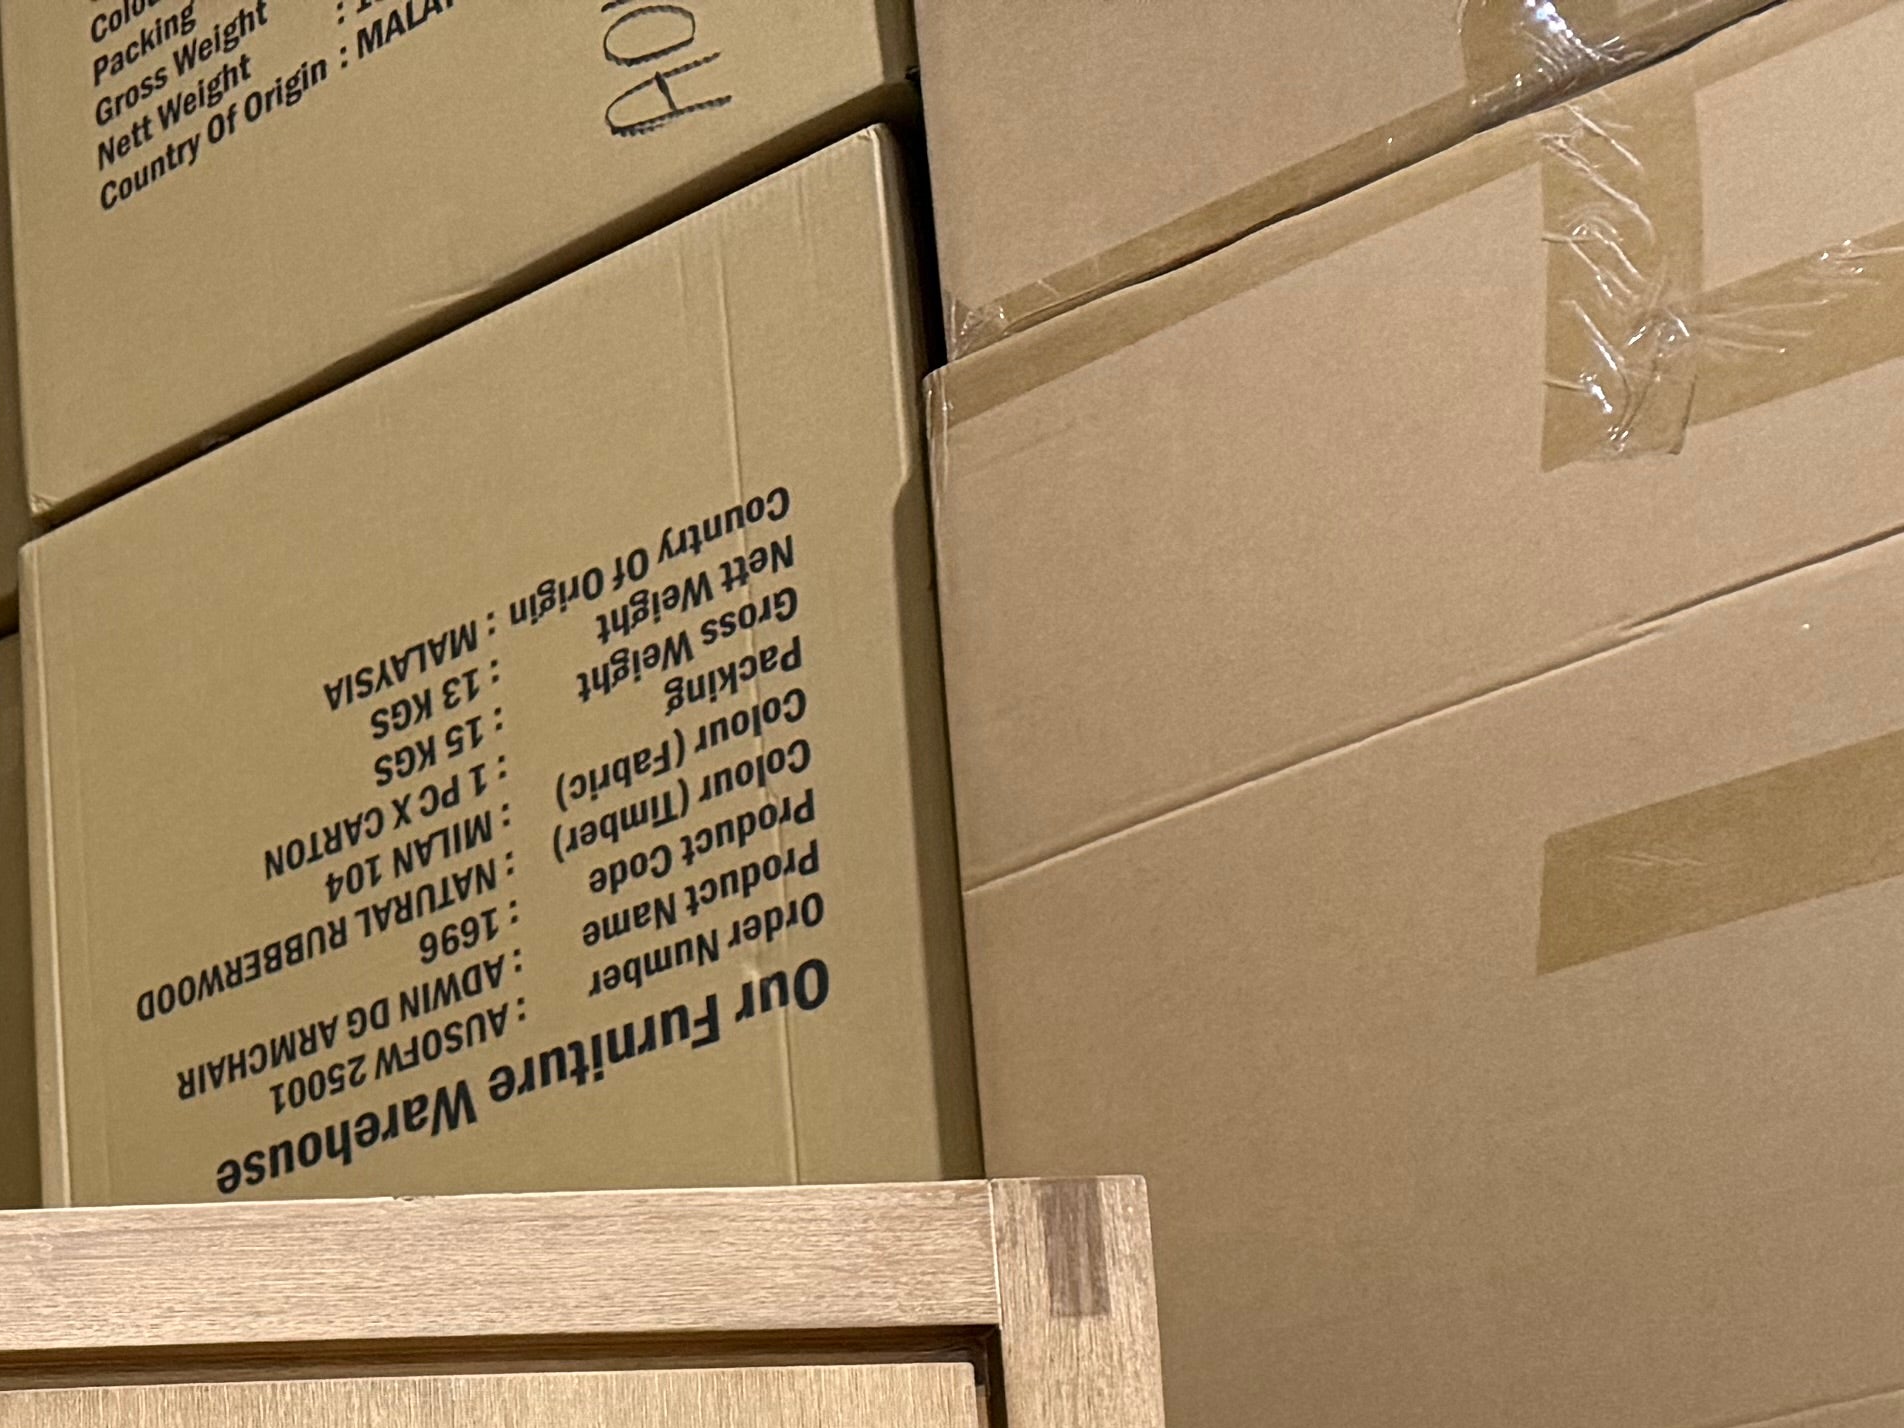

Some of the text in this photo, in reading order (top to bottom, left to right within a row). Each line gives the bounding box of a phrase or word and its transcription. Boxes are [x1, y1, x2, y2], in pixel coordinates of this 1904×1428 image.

[95, 66, 168, 126] Gross
[172, 0, 268, 78] Weight
[97, 54, 252, 170] Nett Weight
[99, 58, 328, 210] Country Of Origin
[321, 487, 789, 713] Country Of Origin MALAYSIA
[136, 740, 810, 1025] Colour (Timber) NATURAL RUBBERWOOD
[323, 689, 806, 904] Colour (Fabric) MILAN 104
[216, 959, 831, 1196] Our Furniture Warehouse
